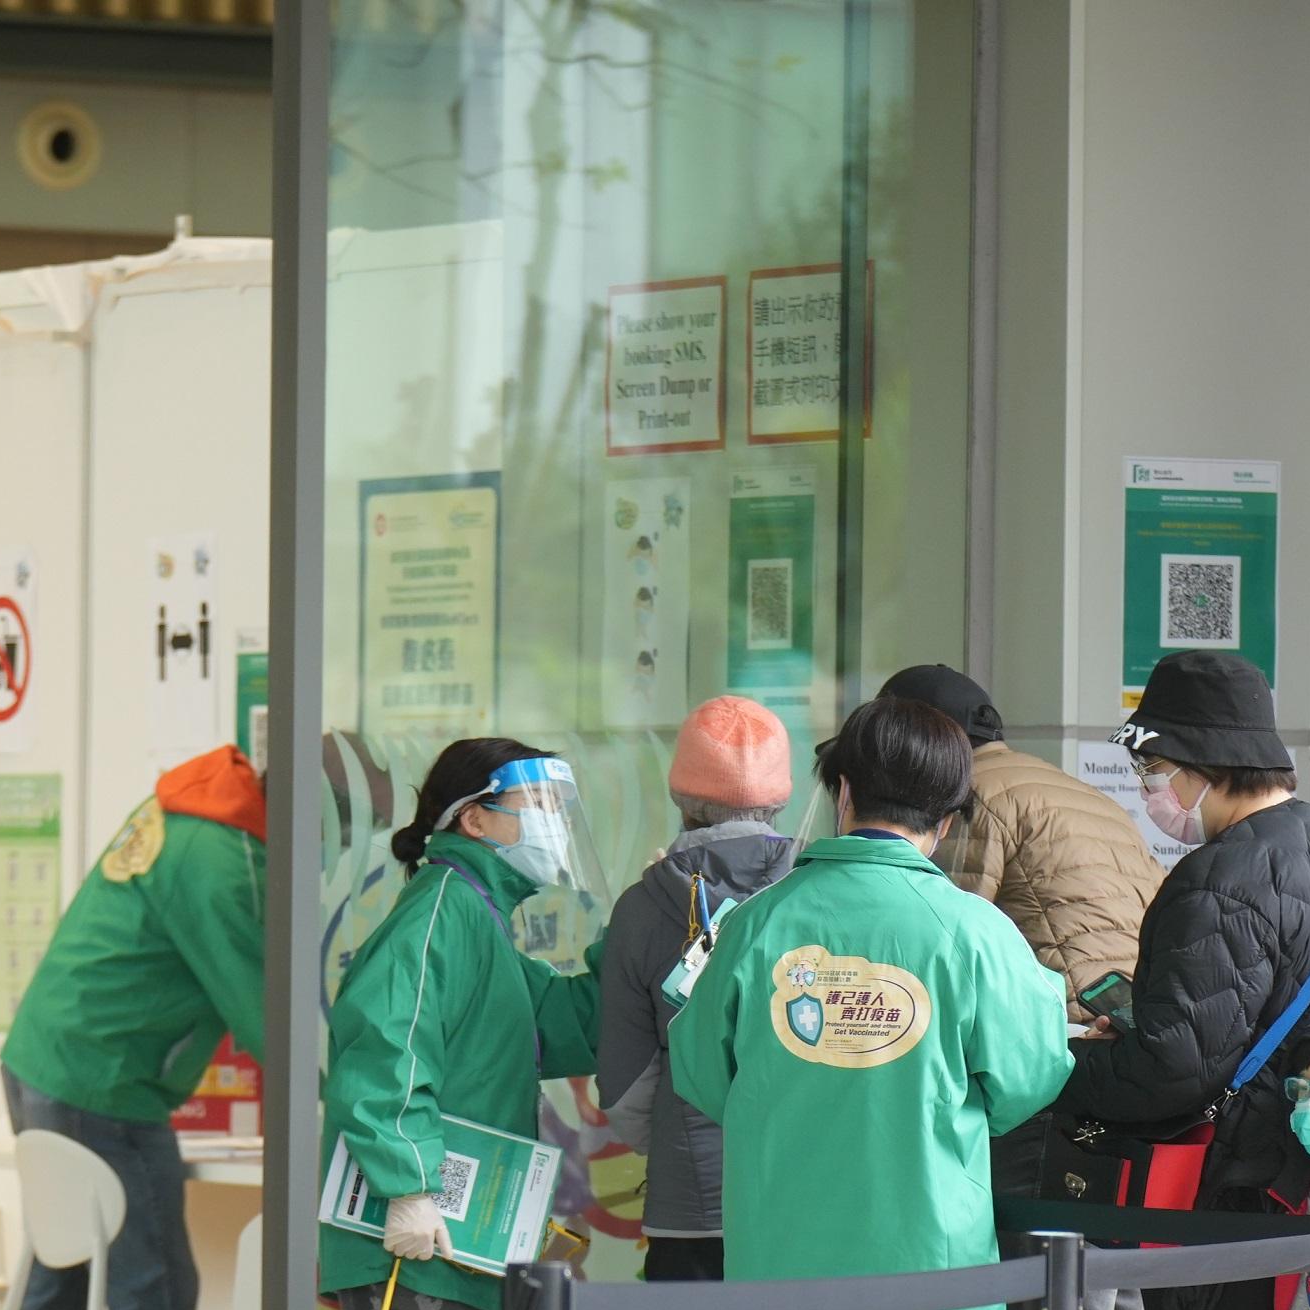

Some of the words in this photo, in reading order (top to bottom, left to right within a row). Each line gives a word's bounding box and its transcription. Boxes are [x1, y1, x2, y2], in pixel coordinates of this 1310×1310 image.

[616, 314, 652, 335] Please
[656, 311, 685, 328] show
[688, 312, 717, 334] your
[623, 346, 672, 368] booking
[616, 379, 657, 400] Screen
[659, 375, 695, 400] Dump
[697, 378, 713, 393] or
[638, 409, 691, 430] Print-out
[1110, 723, 1160, 750] RY
[1084, 762, 1129, 778] Monday
[825, 990, 884, 1006] 護己護人
[840, 1007, 902, 1022] 齊打疫苗
